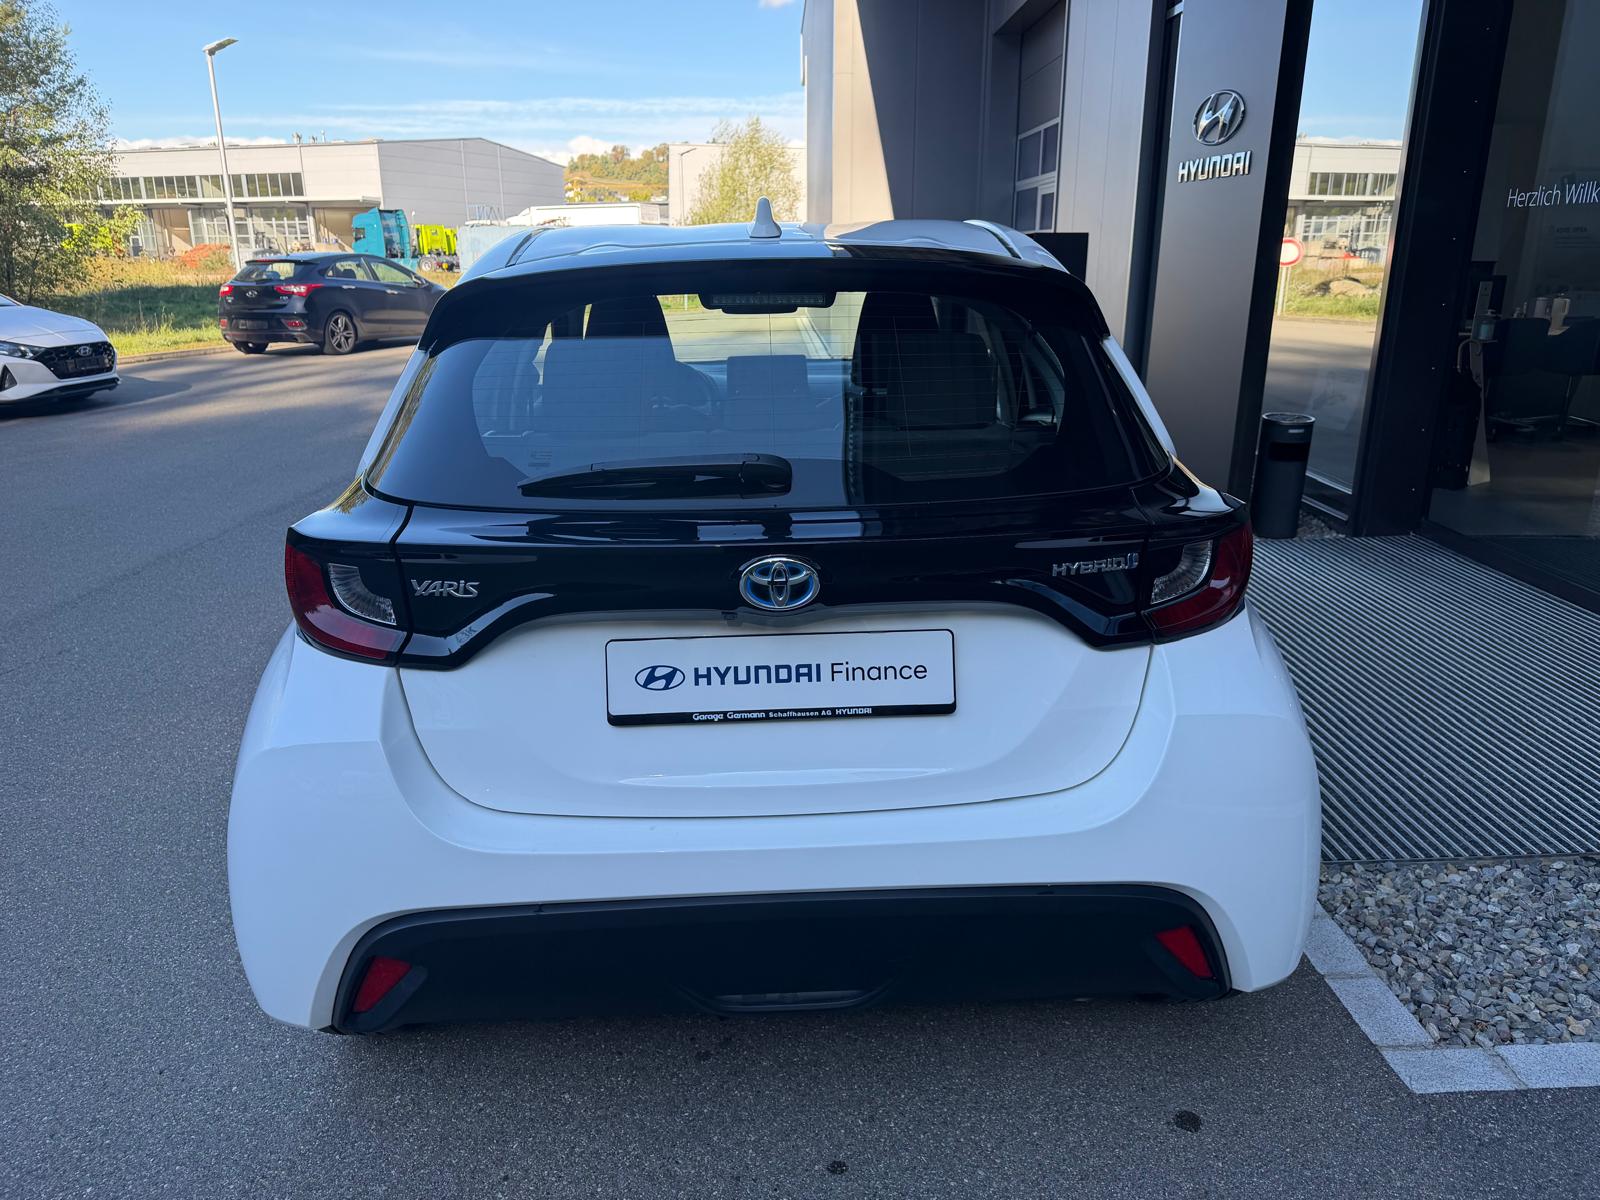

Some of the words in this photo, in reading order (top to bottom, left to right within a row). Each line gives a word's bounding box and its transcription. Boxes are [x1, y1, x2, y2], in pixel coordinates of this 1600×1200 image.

[1178, 150, 1251, 183] HYUNDAI
[1507, 184, 1561, 207] Herzlich
[1052, 557, 1126, 576] HYBRID
[694, 663, 822, 687] HYUNDAI
[830, 661, 928, 682] Finance
[768, 710, 819, 718] Schaffhausen
[835, 707, 872, 715] HYUNDAI
